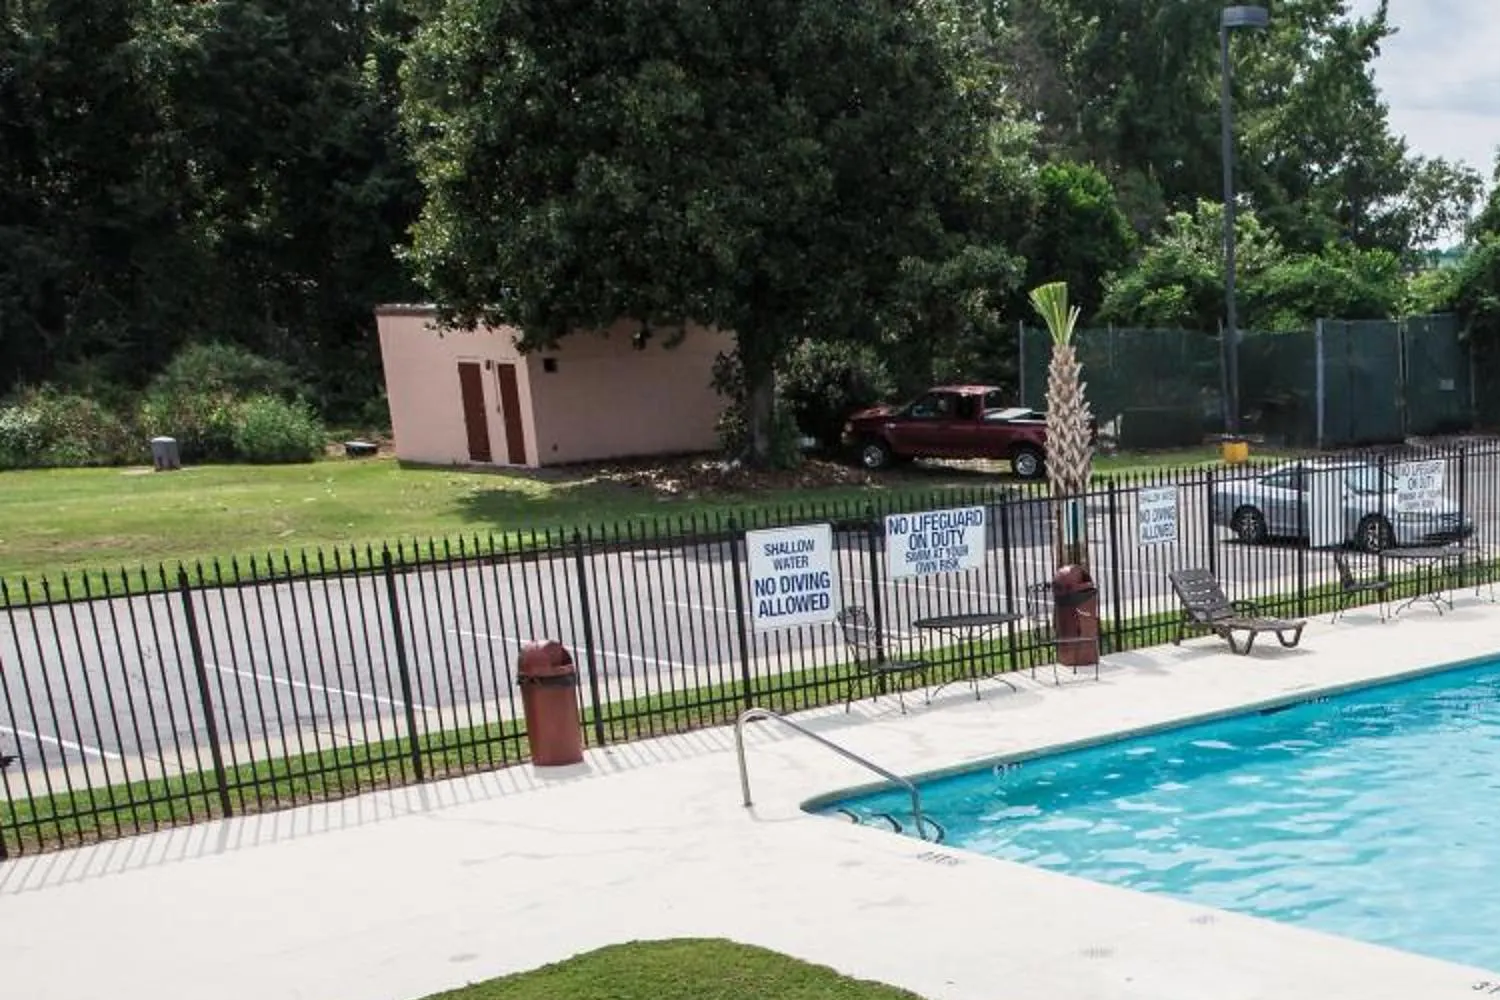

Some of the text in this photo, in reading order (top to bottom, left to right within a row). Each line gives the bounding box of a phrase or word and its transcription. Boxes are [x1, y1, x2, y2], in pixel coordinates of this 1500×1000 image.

[889, 509, 983, 535] NO LIFEGUARD
[764, 539, 815, 557] SHALLOW
[909, 528, 965, 551] ON DUTY
[773, 555, 809, 572] WATER
[755, 571, 831, 597] NO DIVING
[758, 592, 830, 618] ALLOWED
